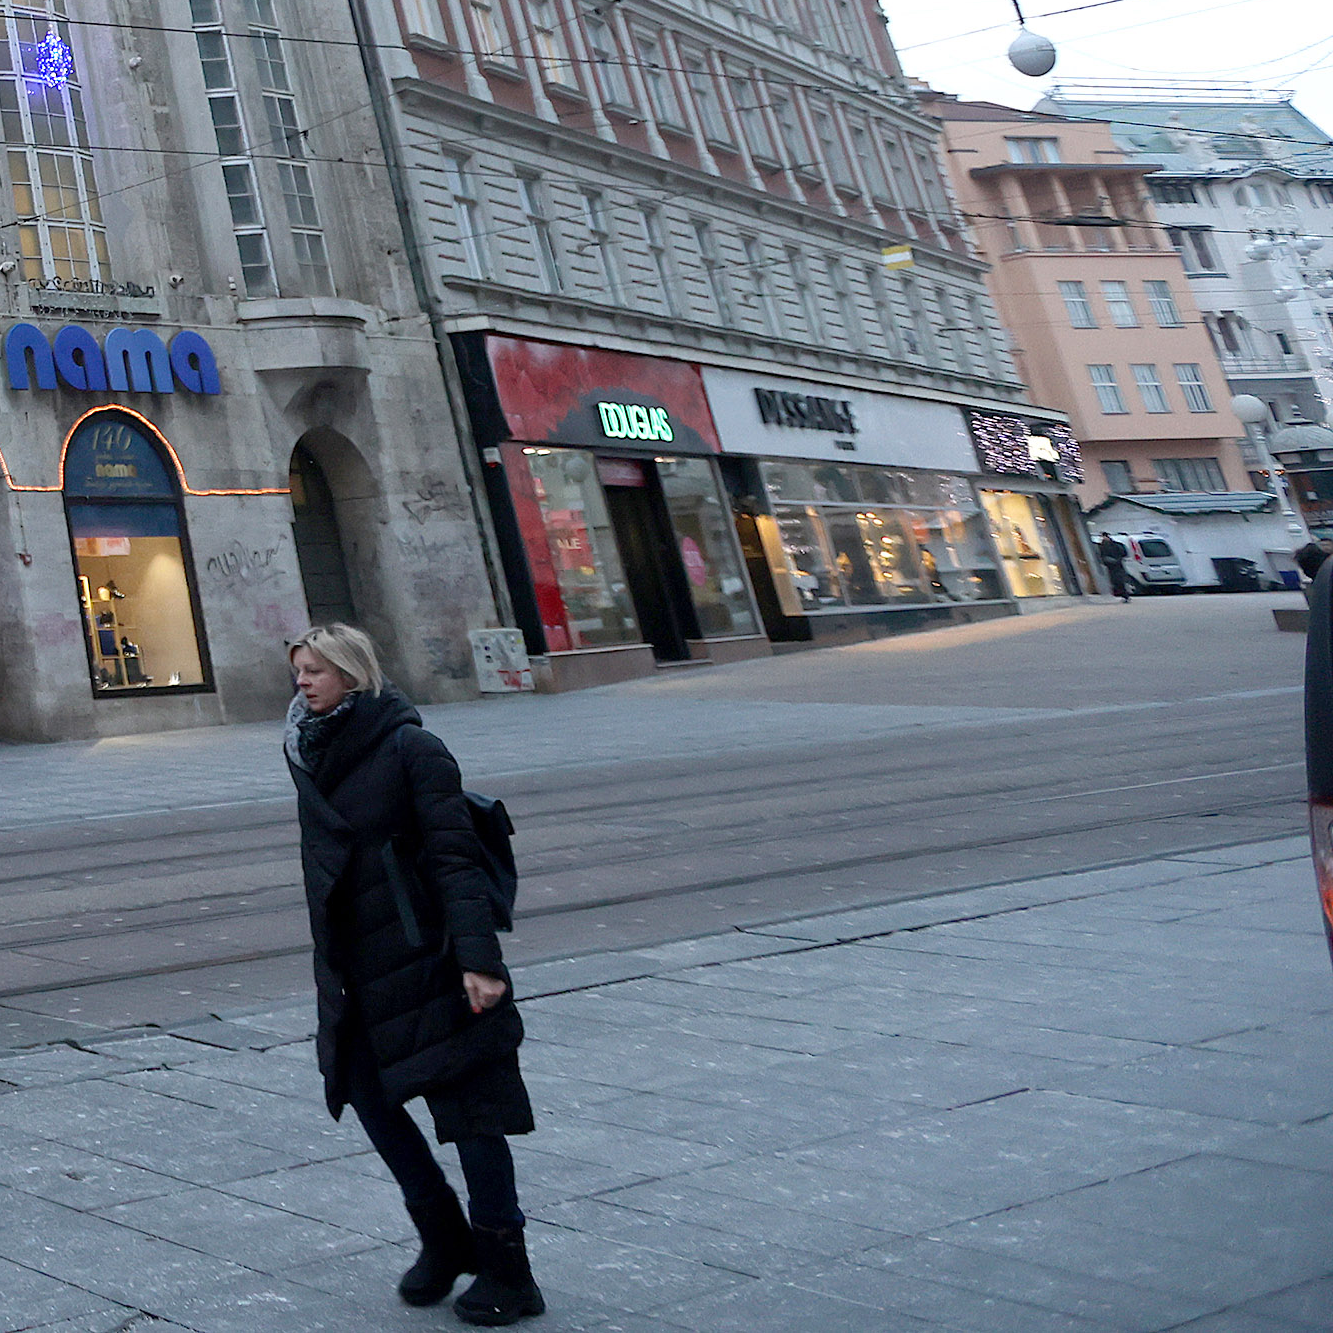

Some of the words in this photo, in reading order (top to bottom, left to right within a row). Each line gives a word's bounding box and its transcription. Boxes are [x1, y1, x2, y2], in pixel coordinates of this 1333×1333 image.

[6, 322, 220, 395] nama
[597, 401, 674, 442] DOUGLAS
[556, 537, 582, 550] ALE
